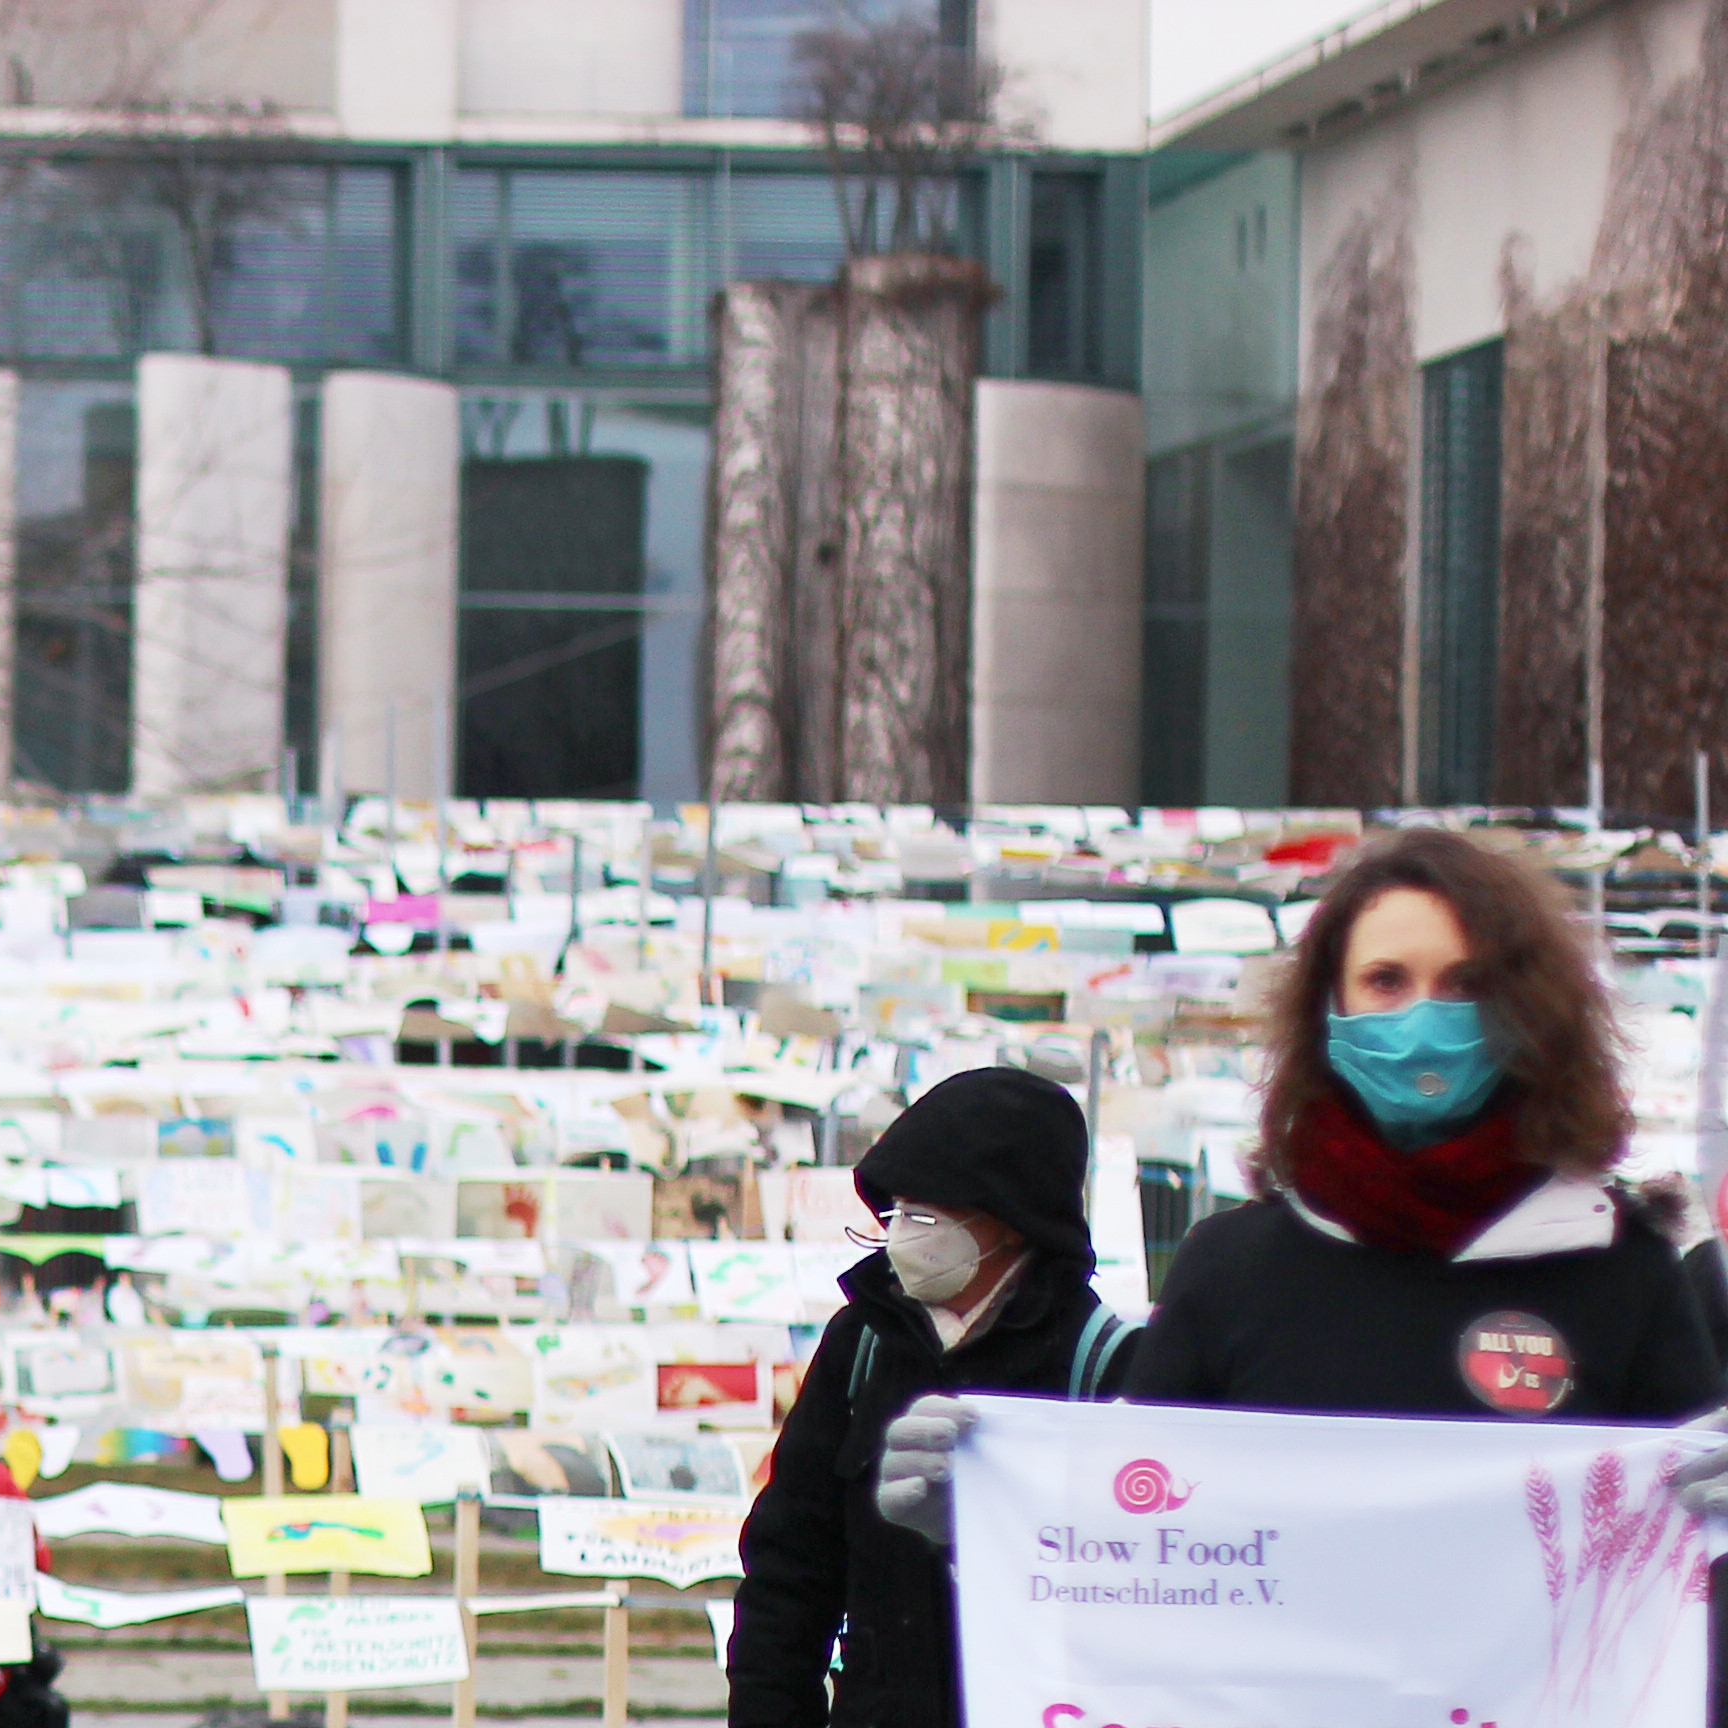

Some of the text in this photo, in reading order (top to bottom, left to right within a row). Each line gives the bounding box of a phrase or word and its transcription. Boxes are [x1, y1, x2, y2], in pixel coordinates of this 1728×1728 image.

[1478, 1332, 1553, 1357] ALL YOU
[1037, 1525, 1142, 1564] Slow
[1030, 1575, 1218, 1606] Deutschland
